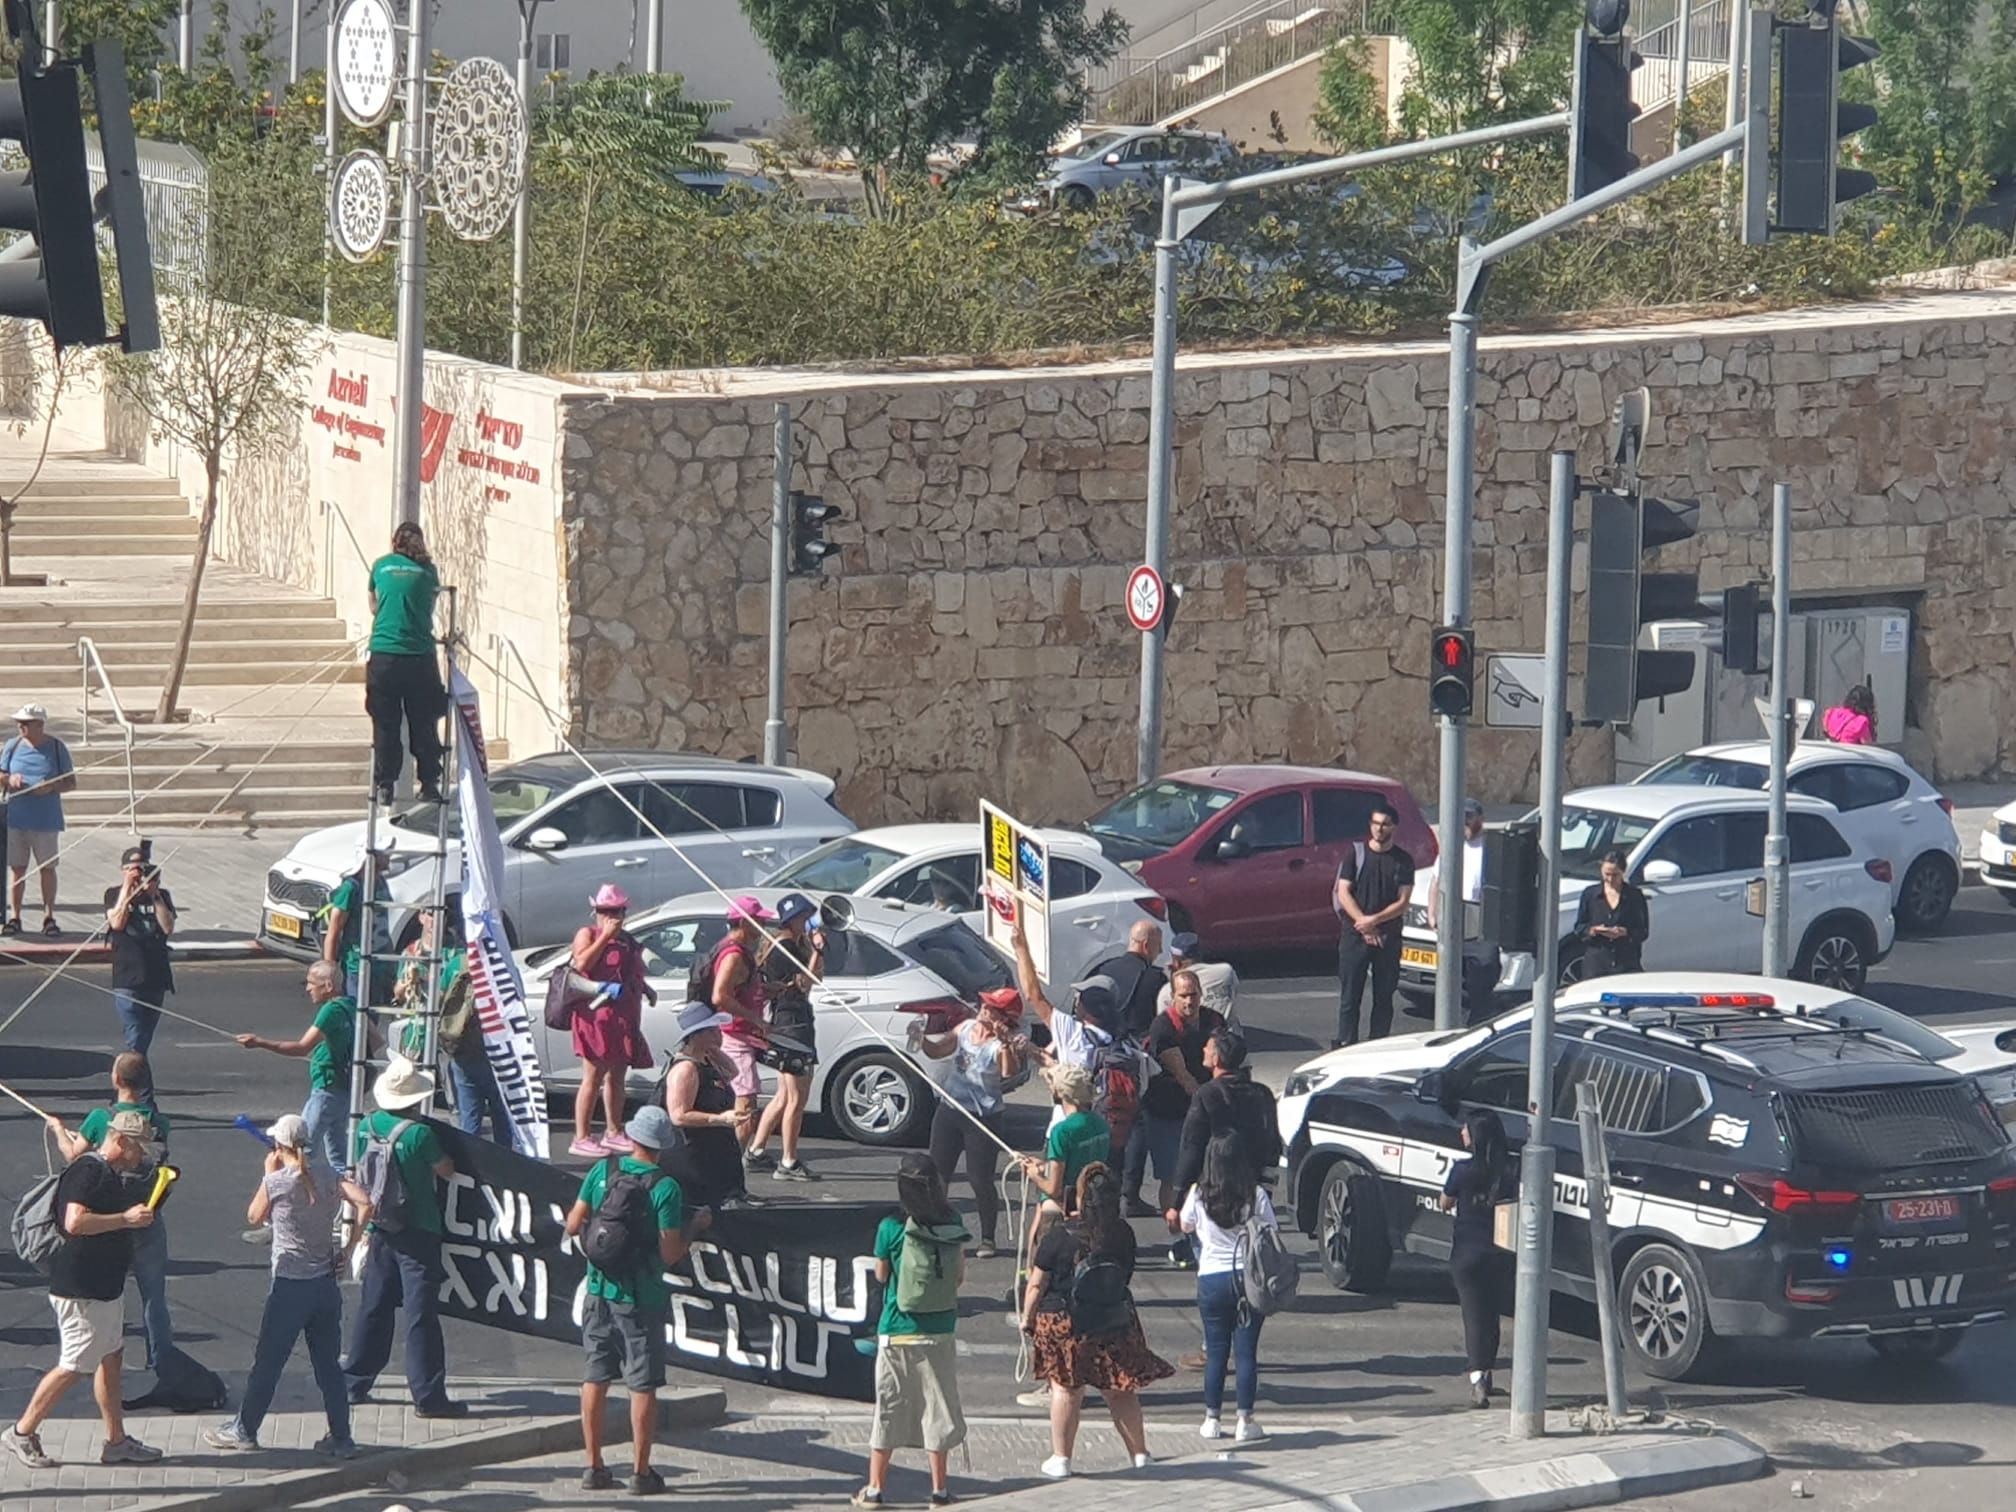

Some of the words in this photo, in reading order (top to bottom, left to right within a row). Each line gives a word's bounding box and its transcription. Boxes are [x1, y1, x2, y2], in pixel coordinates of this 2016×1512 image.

[327, 367, 368, 409] Azrieli
[1416, 1194, 1458, 1217] POL
[438, 1241, 549, 1321] צאו
